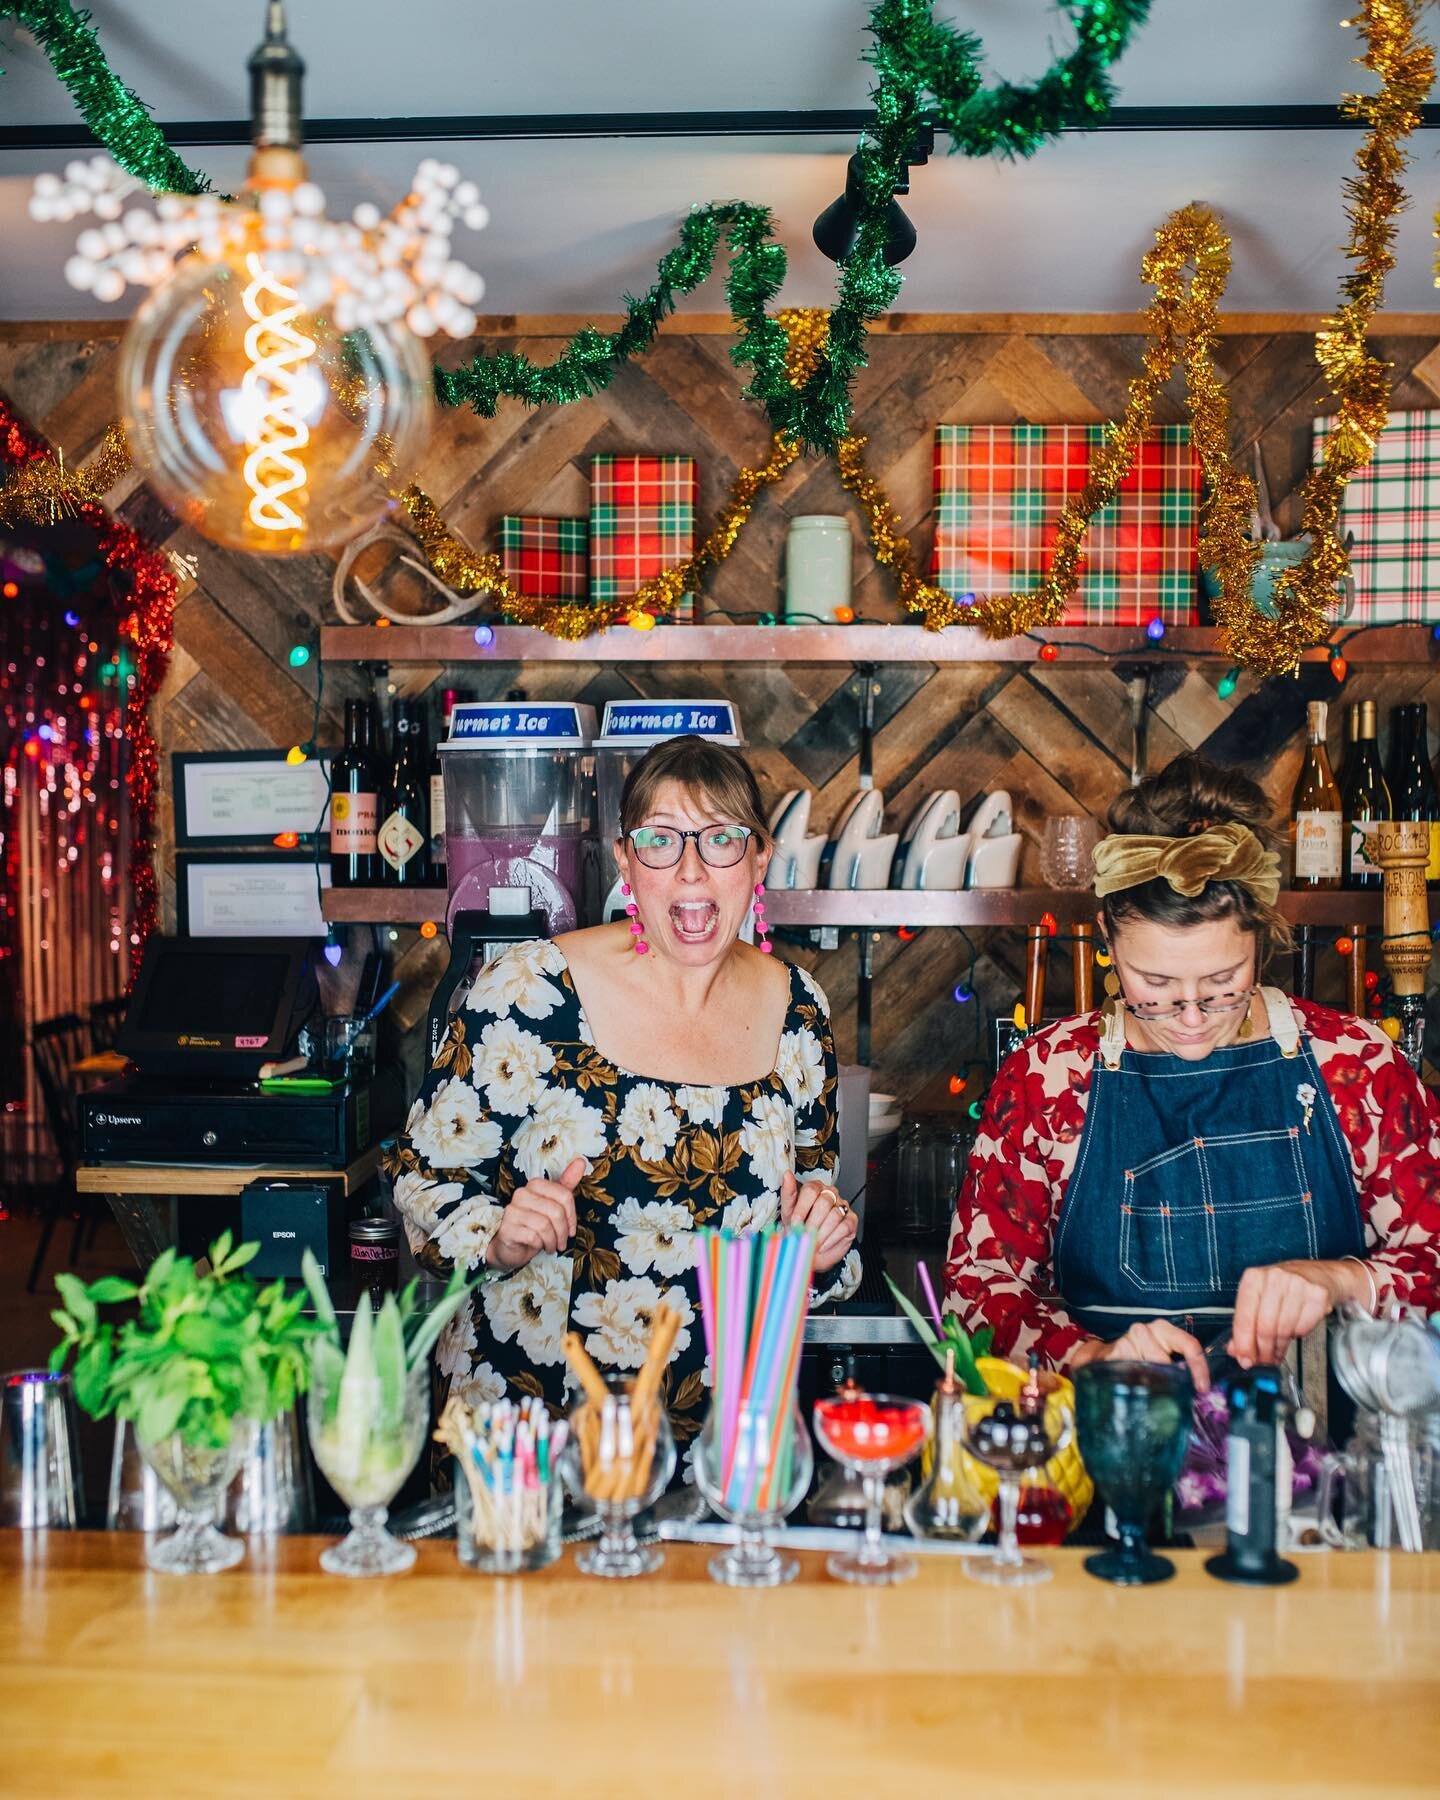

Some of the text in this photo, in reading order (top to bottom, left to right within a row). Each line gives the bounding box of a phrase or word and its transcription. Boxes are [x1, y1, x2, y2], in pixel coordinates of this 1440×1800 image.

[455, 713, 550, 732] urmet Ice
[688, 711, 717, 729] Ice
[108, 1114, 142, 1125] Upserve
[272, 1231, 296, 1239] EPSON
